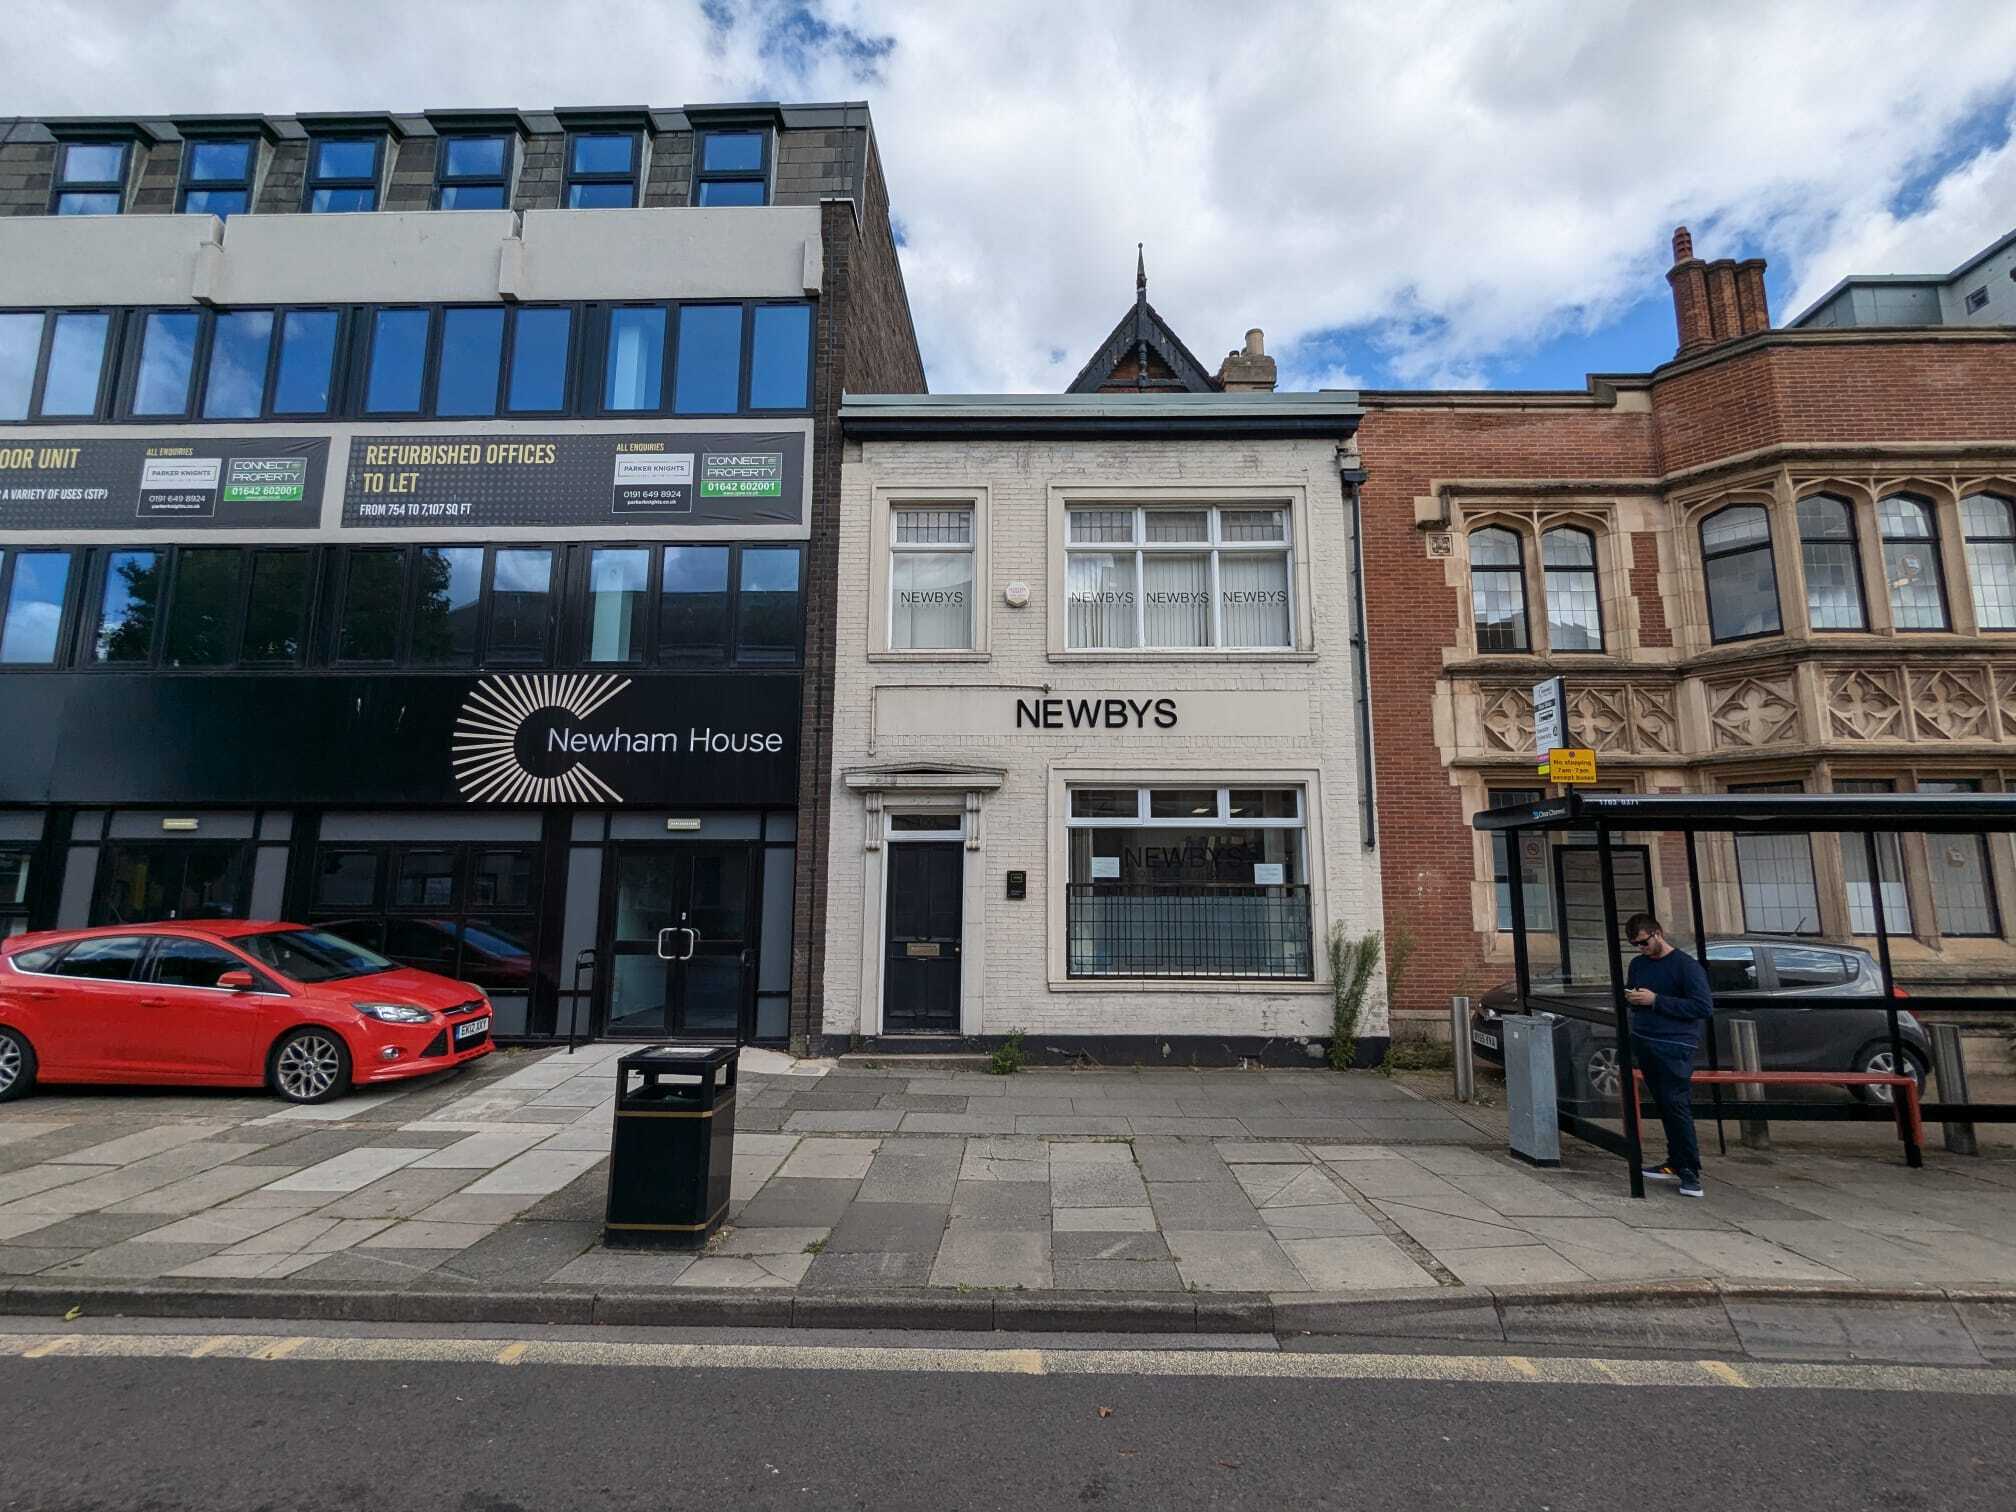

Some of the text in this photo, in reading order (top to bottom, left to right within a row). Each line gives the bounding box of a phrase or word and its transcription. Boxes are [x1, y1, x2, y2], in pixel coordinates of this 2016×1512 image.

[146, 447, 158, 456] ALL
[616, 442, 665, 452] ALL ENQUIRIES
[38, 448, 80, 469] UNIT
[366, 443, 556, 465] REFURBISHED OFFICES
[234, 461, 291, 470] CONNECT
[707, 456, 768, 465] CONNECT
[232, 472, 300, 481] PROPERTY
[707, 468, 776, 477] PROPERTY
[363, 472, 419, 492] TO LET
[708, 482, 775, 491] 01642 602001
[2, 488, 109, 500] A VARIETY OF USES (STP)
[232, 487, 261, 495] 01642
[360, 503, 472, 516] FROM 754 TO 7,107 SQ FT
[900, 591, 963, 603] NEWBYS
[1071, 591, 1134, 603] NEWBYS
[1146, 591, 1209, 603] NEWBYS
[1223, 591, 1286, 602] NEWBYS
[1016, 698, 1178, 729] NEWBYS
[548, 727, 783, 752] Newham House
[1124, 847, 1243, 868] NEWBYS
